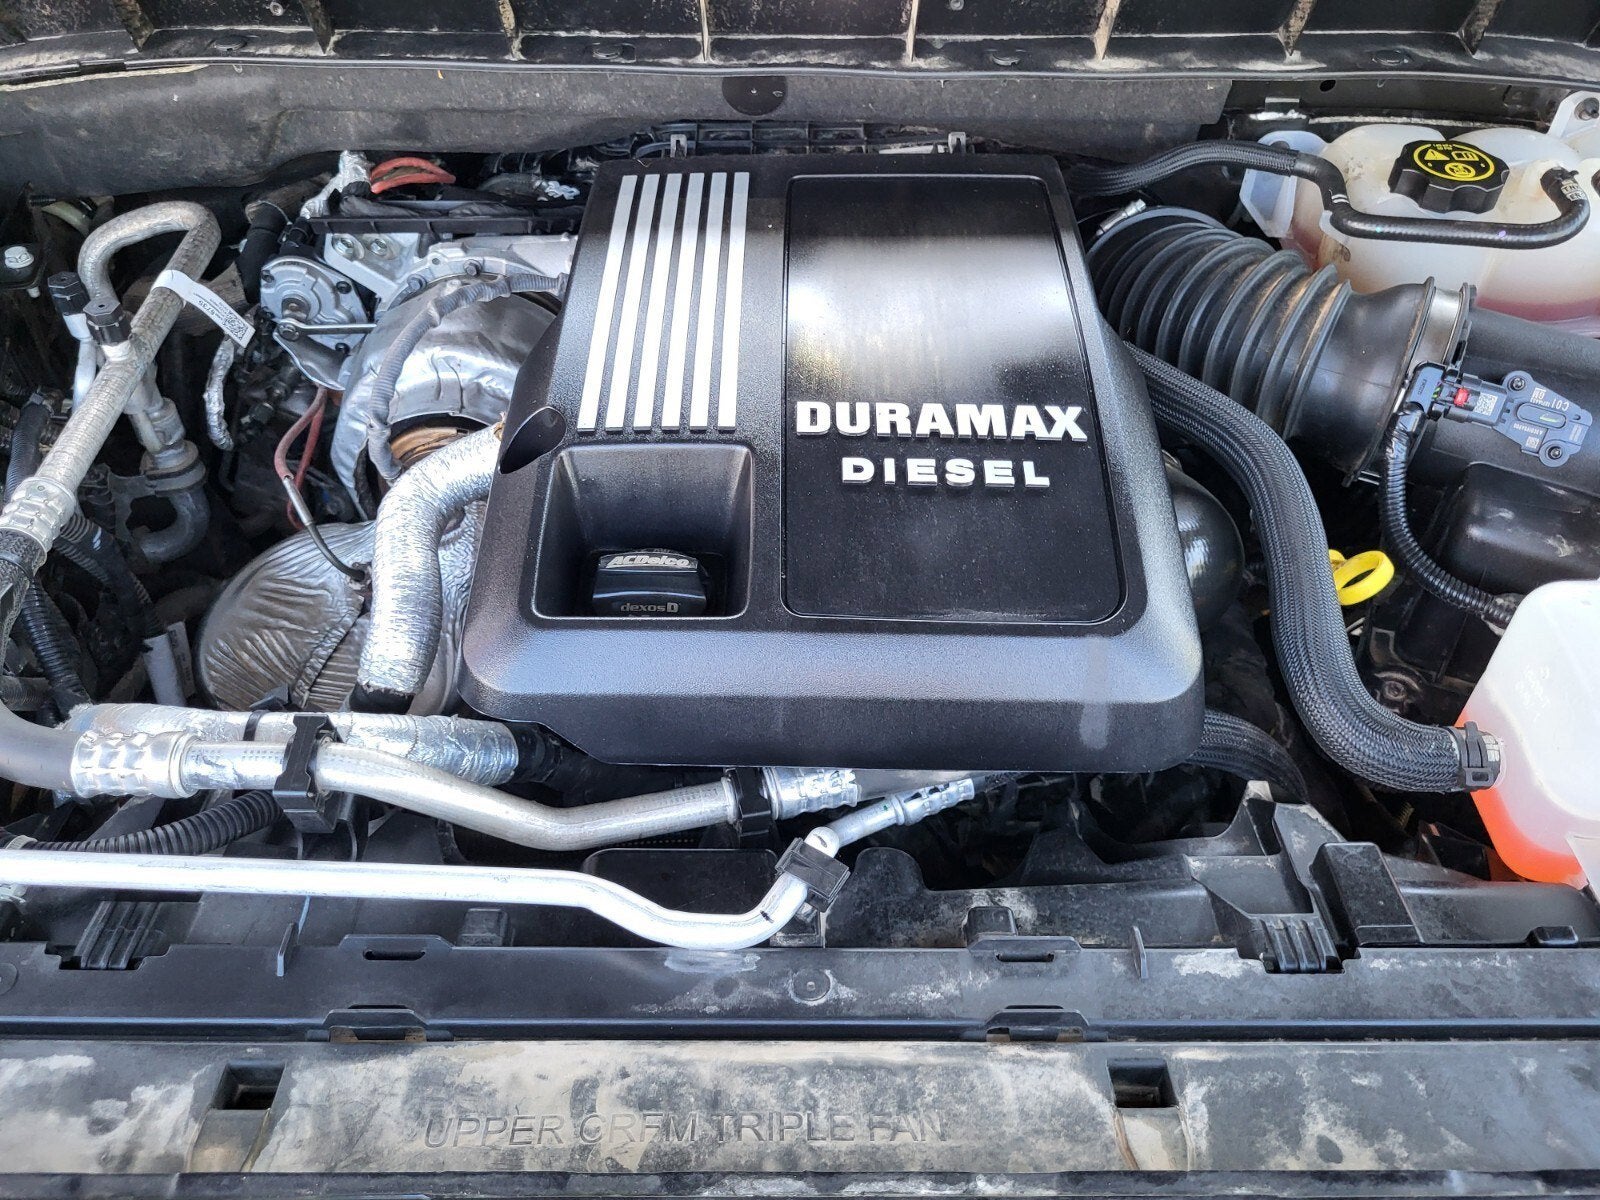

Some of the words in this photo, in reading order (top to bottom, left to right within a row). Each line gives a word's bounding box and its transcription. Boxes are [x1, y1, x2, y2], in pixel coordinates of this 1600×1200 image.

[795, 401, 1088, 442] DURAMAX
[841, 456, 1050, 488] DIESEL
[605, 555, 691, 569] ACDelco
[423, 1115, 565, 1149] UPPER
[712, 1111, 855, 1143] TRIPLE
[866, 1111, 948, 1143] FAN
